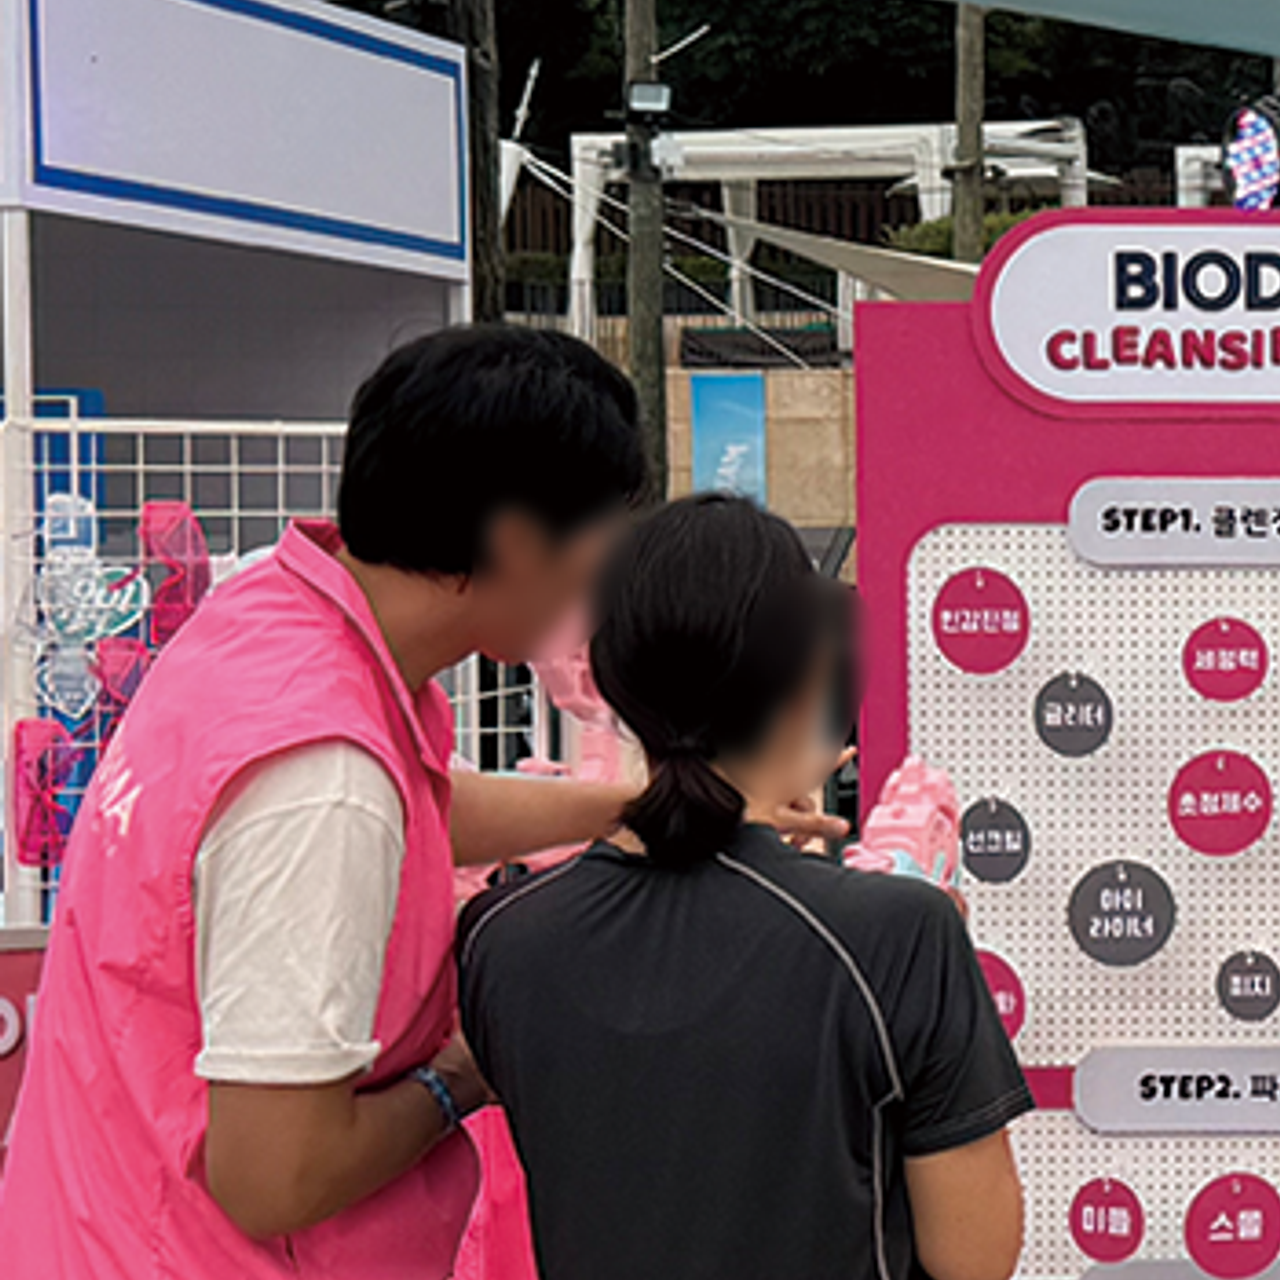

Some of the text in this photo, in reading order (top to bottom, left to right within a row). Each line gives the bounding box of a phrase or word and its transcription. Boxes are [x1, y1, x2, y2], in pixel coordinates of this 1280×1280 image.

[1101, 507, 1201, 533] STEP1.
[1043, 700, 1105, 726] 글리터
[1099, 887, 1144, 912] 아이
[1089, 914, 1155, 939] 라이너
[1139, 1074, 1241, 1101] STEP2.
